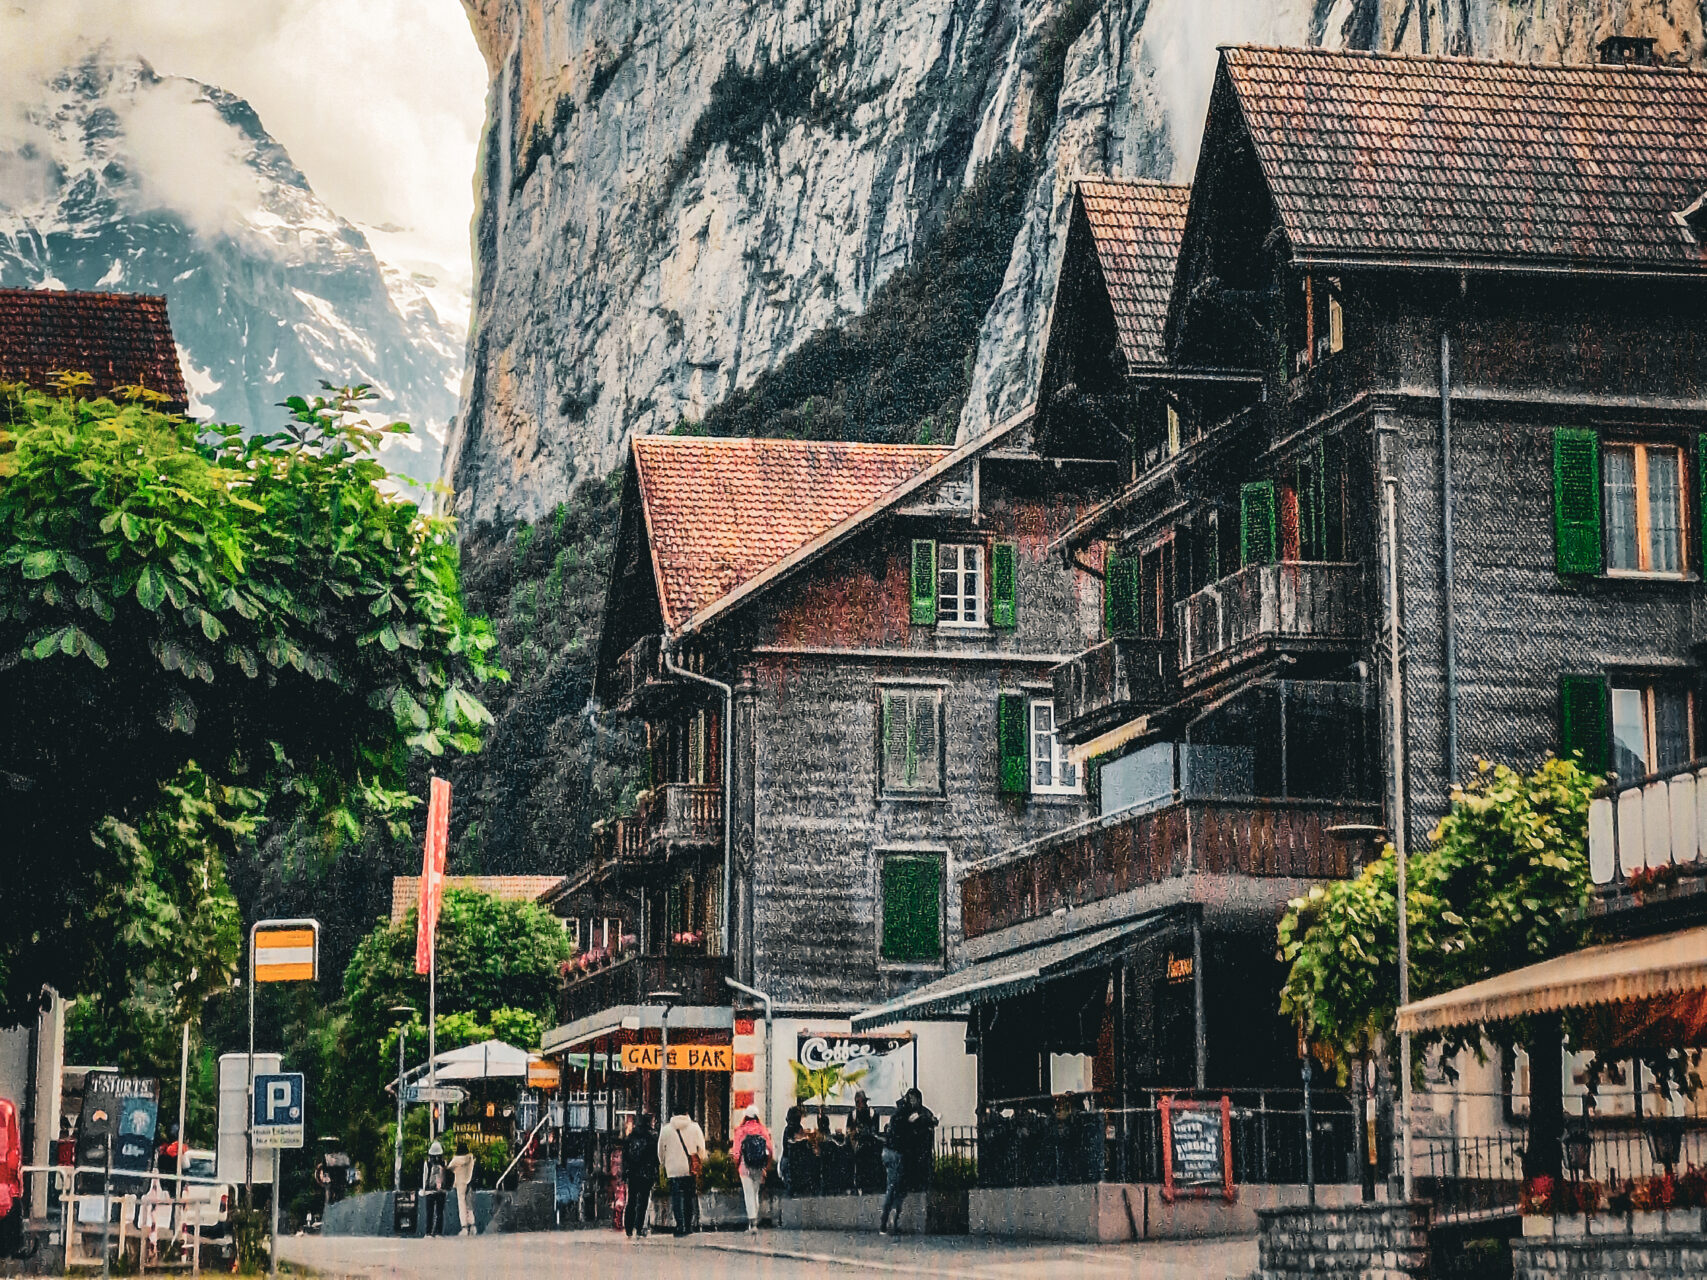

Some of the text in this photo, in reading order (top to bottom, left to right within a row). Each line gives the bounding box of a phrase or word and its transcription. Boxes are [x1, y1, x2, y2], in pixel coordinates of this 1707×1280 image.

[688, 1049, 726, 1068] BAR
[801, 1037, 875, 1070] Coffee
[267, 1081, 291, 1120] P
